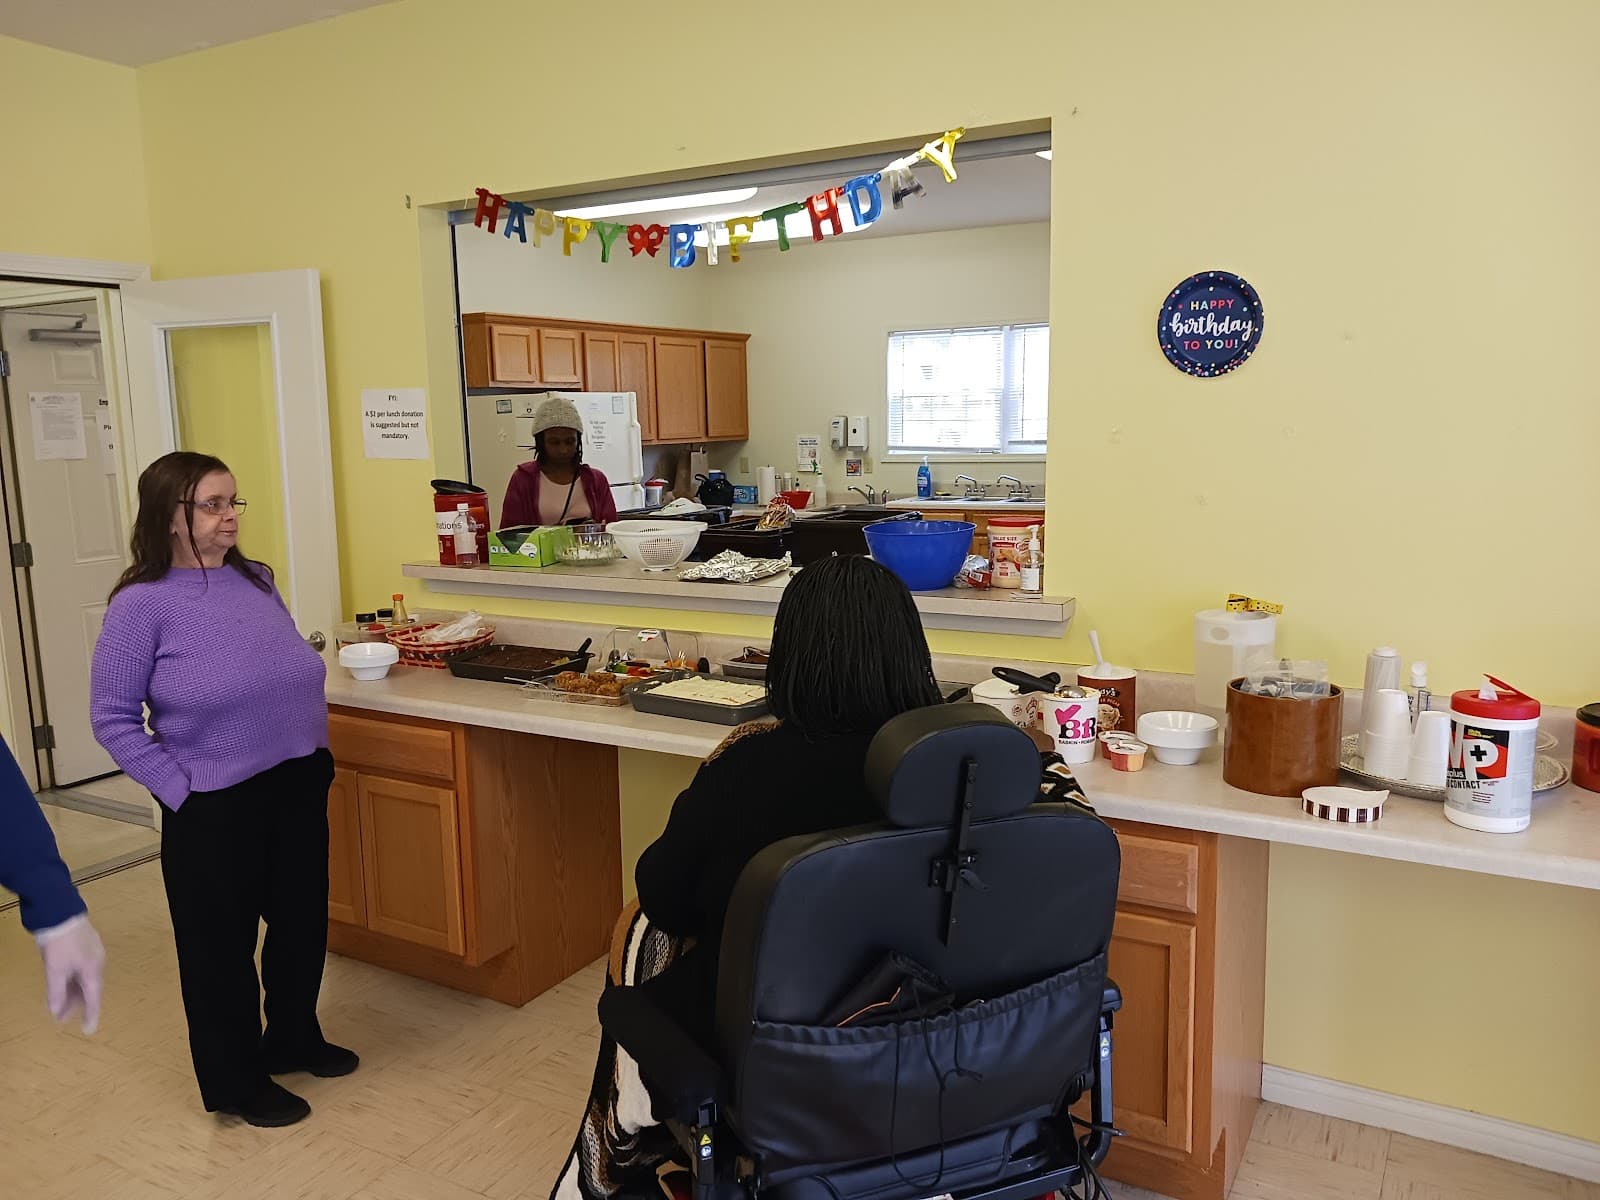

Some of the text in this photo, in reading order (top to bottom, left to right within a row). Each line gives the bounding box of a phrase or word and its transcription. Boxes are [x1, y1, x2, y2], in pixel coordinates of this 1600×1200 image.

[474, 127, 966, 268] HAPPY BIRTHDAY
[1190, 299, 1234, 311] HAPPY
[1169, 312, 1252, 342] birthday
[1183, 339, 1238, 350] TO YOU!
[1058, 717, 1096, 739] BR
[1450, 780, 1480, 790] CONTACT
